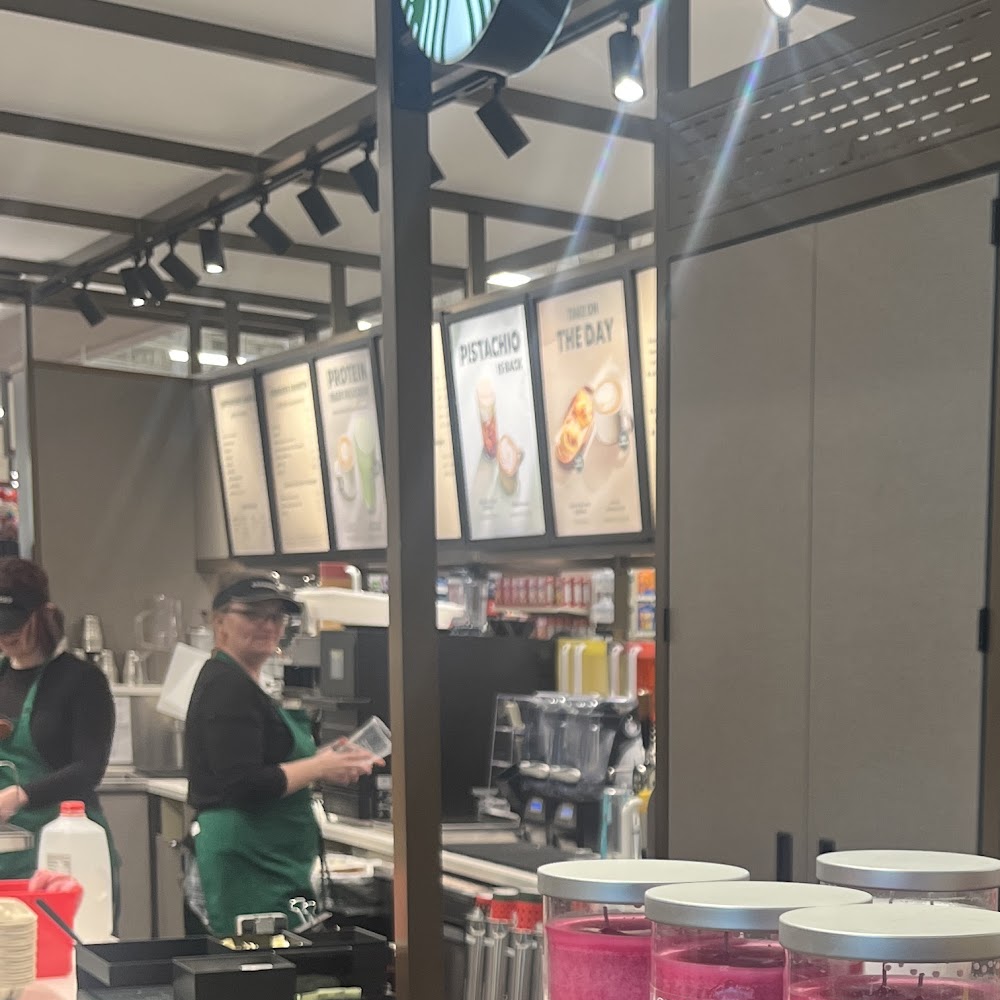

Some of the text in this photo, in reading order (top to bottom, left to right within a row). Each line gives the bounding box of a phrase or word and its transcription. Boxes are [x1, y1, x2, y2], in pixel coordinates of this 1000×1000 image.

[459, 330, 521, 367] PISTACHIO
[556, 317, 614, 353] THE DAY
